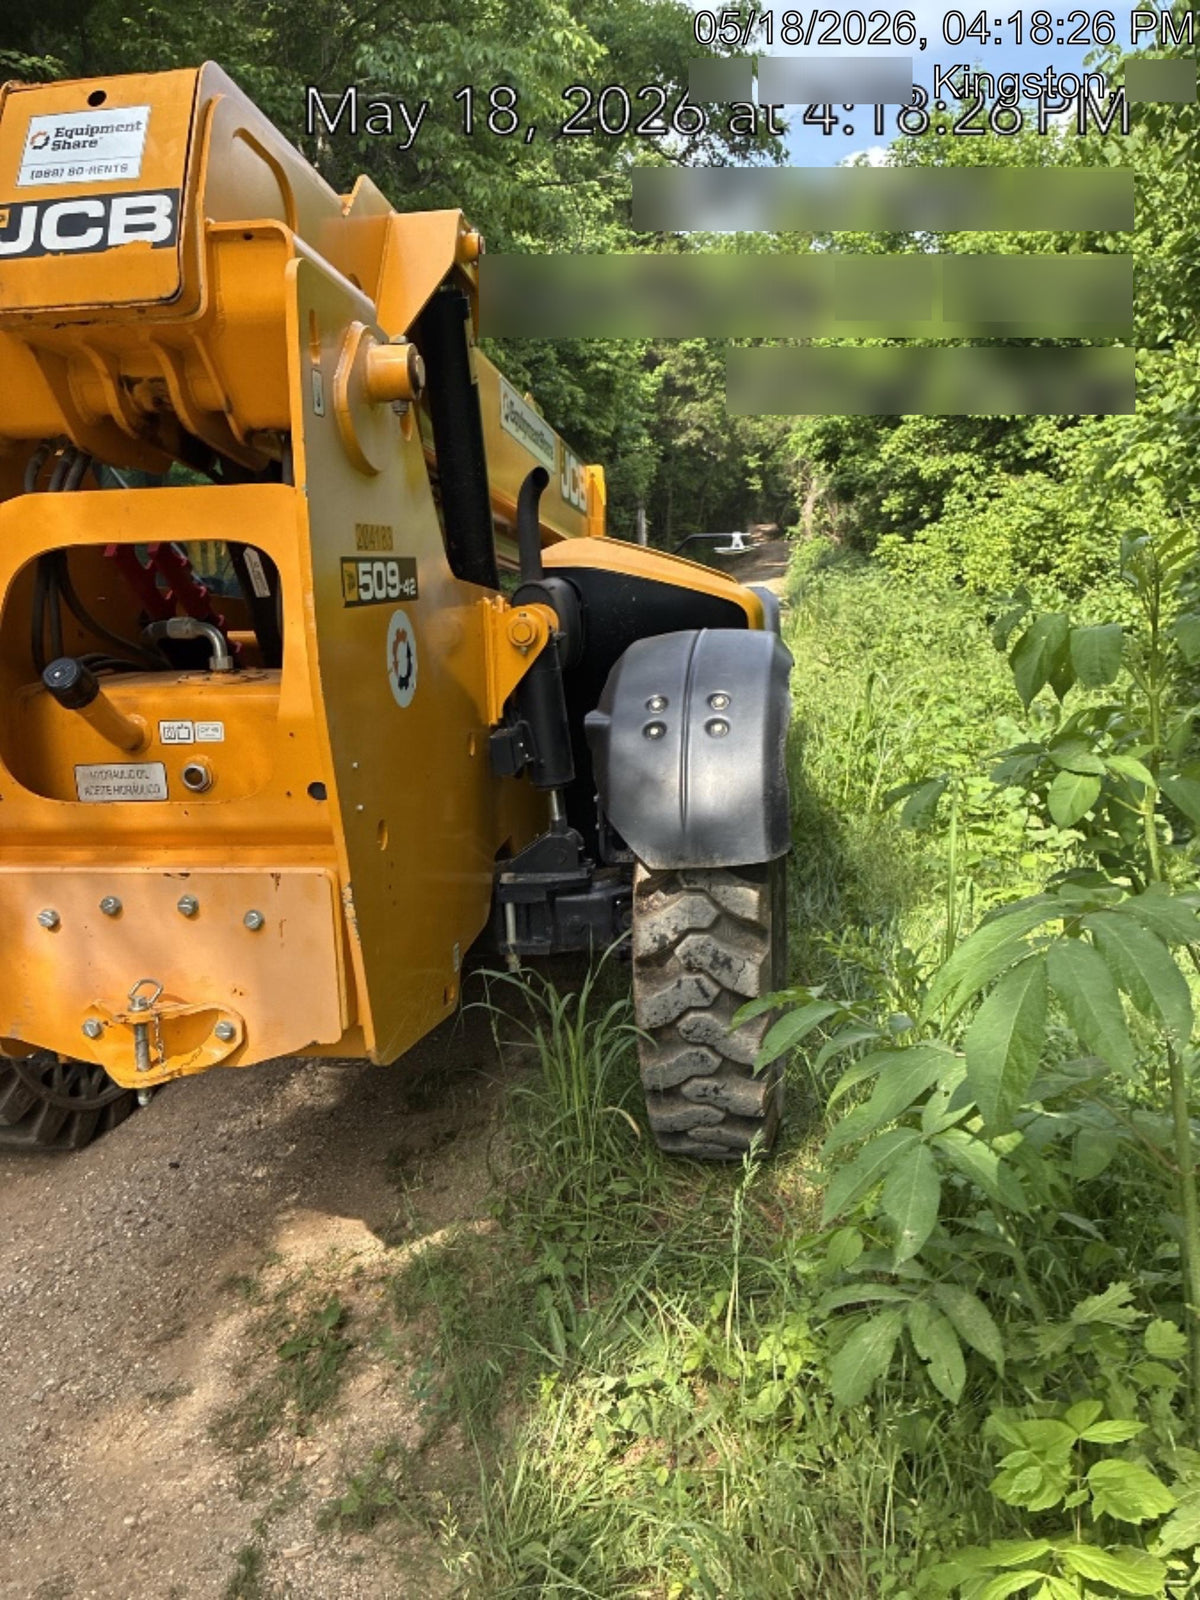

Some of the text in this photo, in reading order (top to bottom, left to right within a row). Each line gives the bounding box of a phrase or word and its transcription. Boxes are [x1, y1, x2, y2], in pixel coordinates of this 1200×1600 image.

[51, 137, 99, 152] Share
[54, 121, 143, 140] Equipment
[0, 194, 173, 255] JCB
[560, 447, 587, 512] JCB
[358, 561, 417, 600] 509-42
